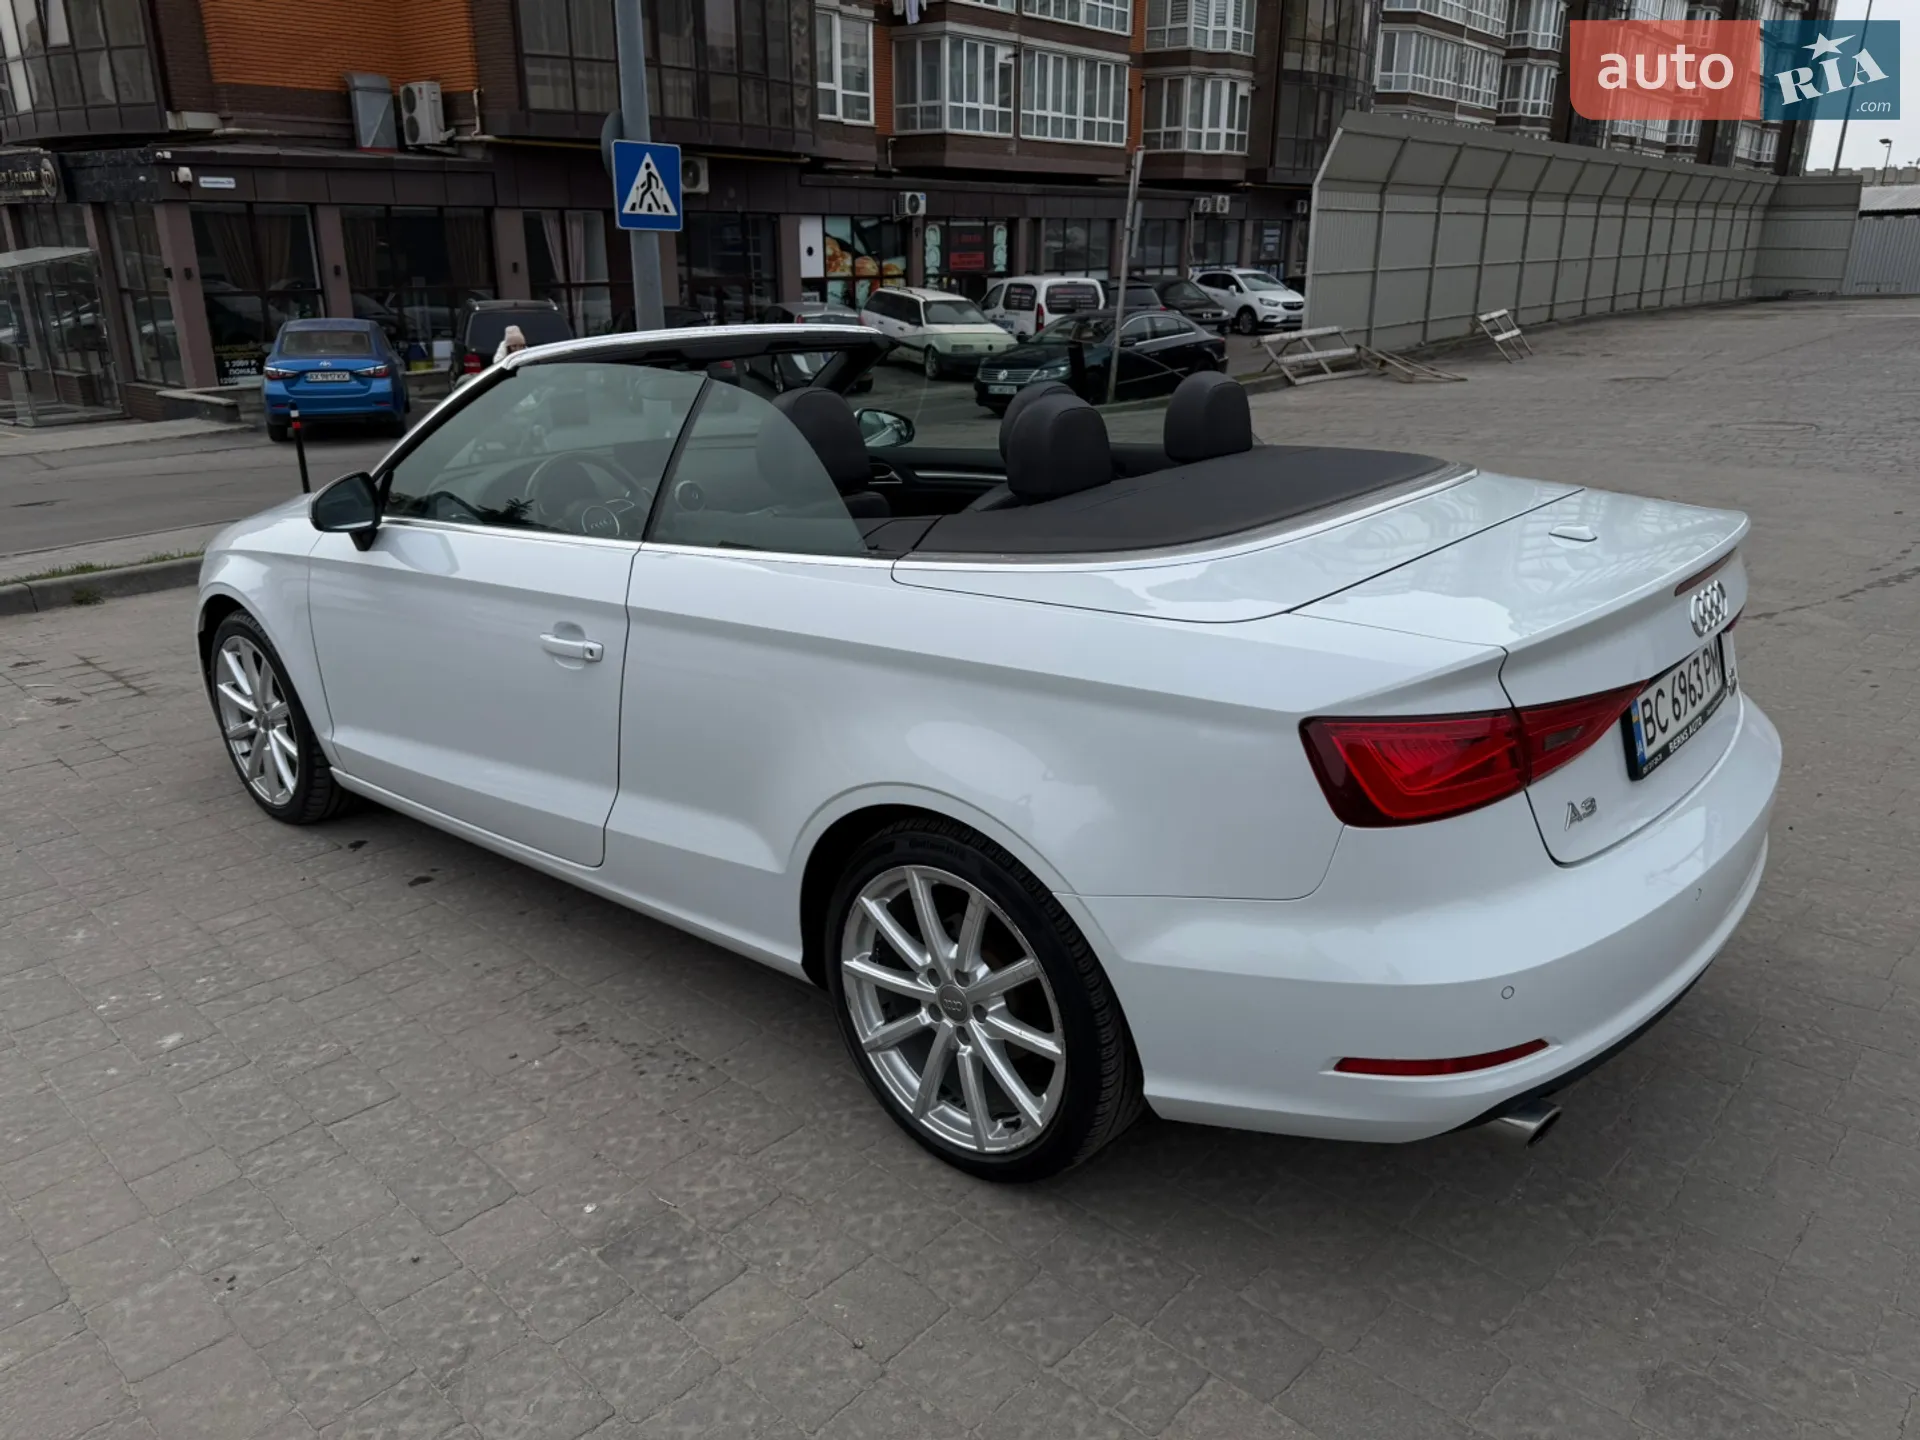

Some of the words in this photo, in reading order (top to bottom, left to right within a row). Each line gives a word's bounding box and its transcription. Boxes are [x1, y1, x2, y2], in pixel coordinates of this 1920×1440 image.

[1641, 688, 1669, 747] BC
[1671, 659, 1704, 722] 6963
[1702, 641, 1722, 693] PM
[1564, 796, 1597, 831] A3
